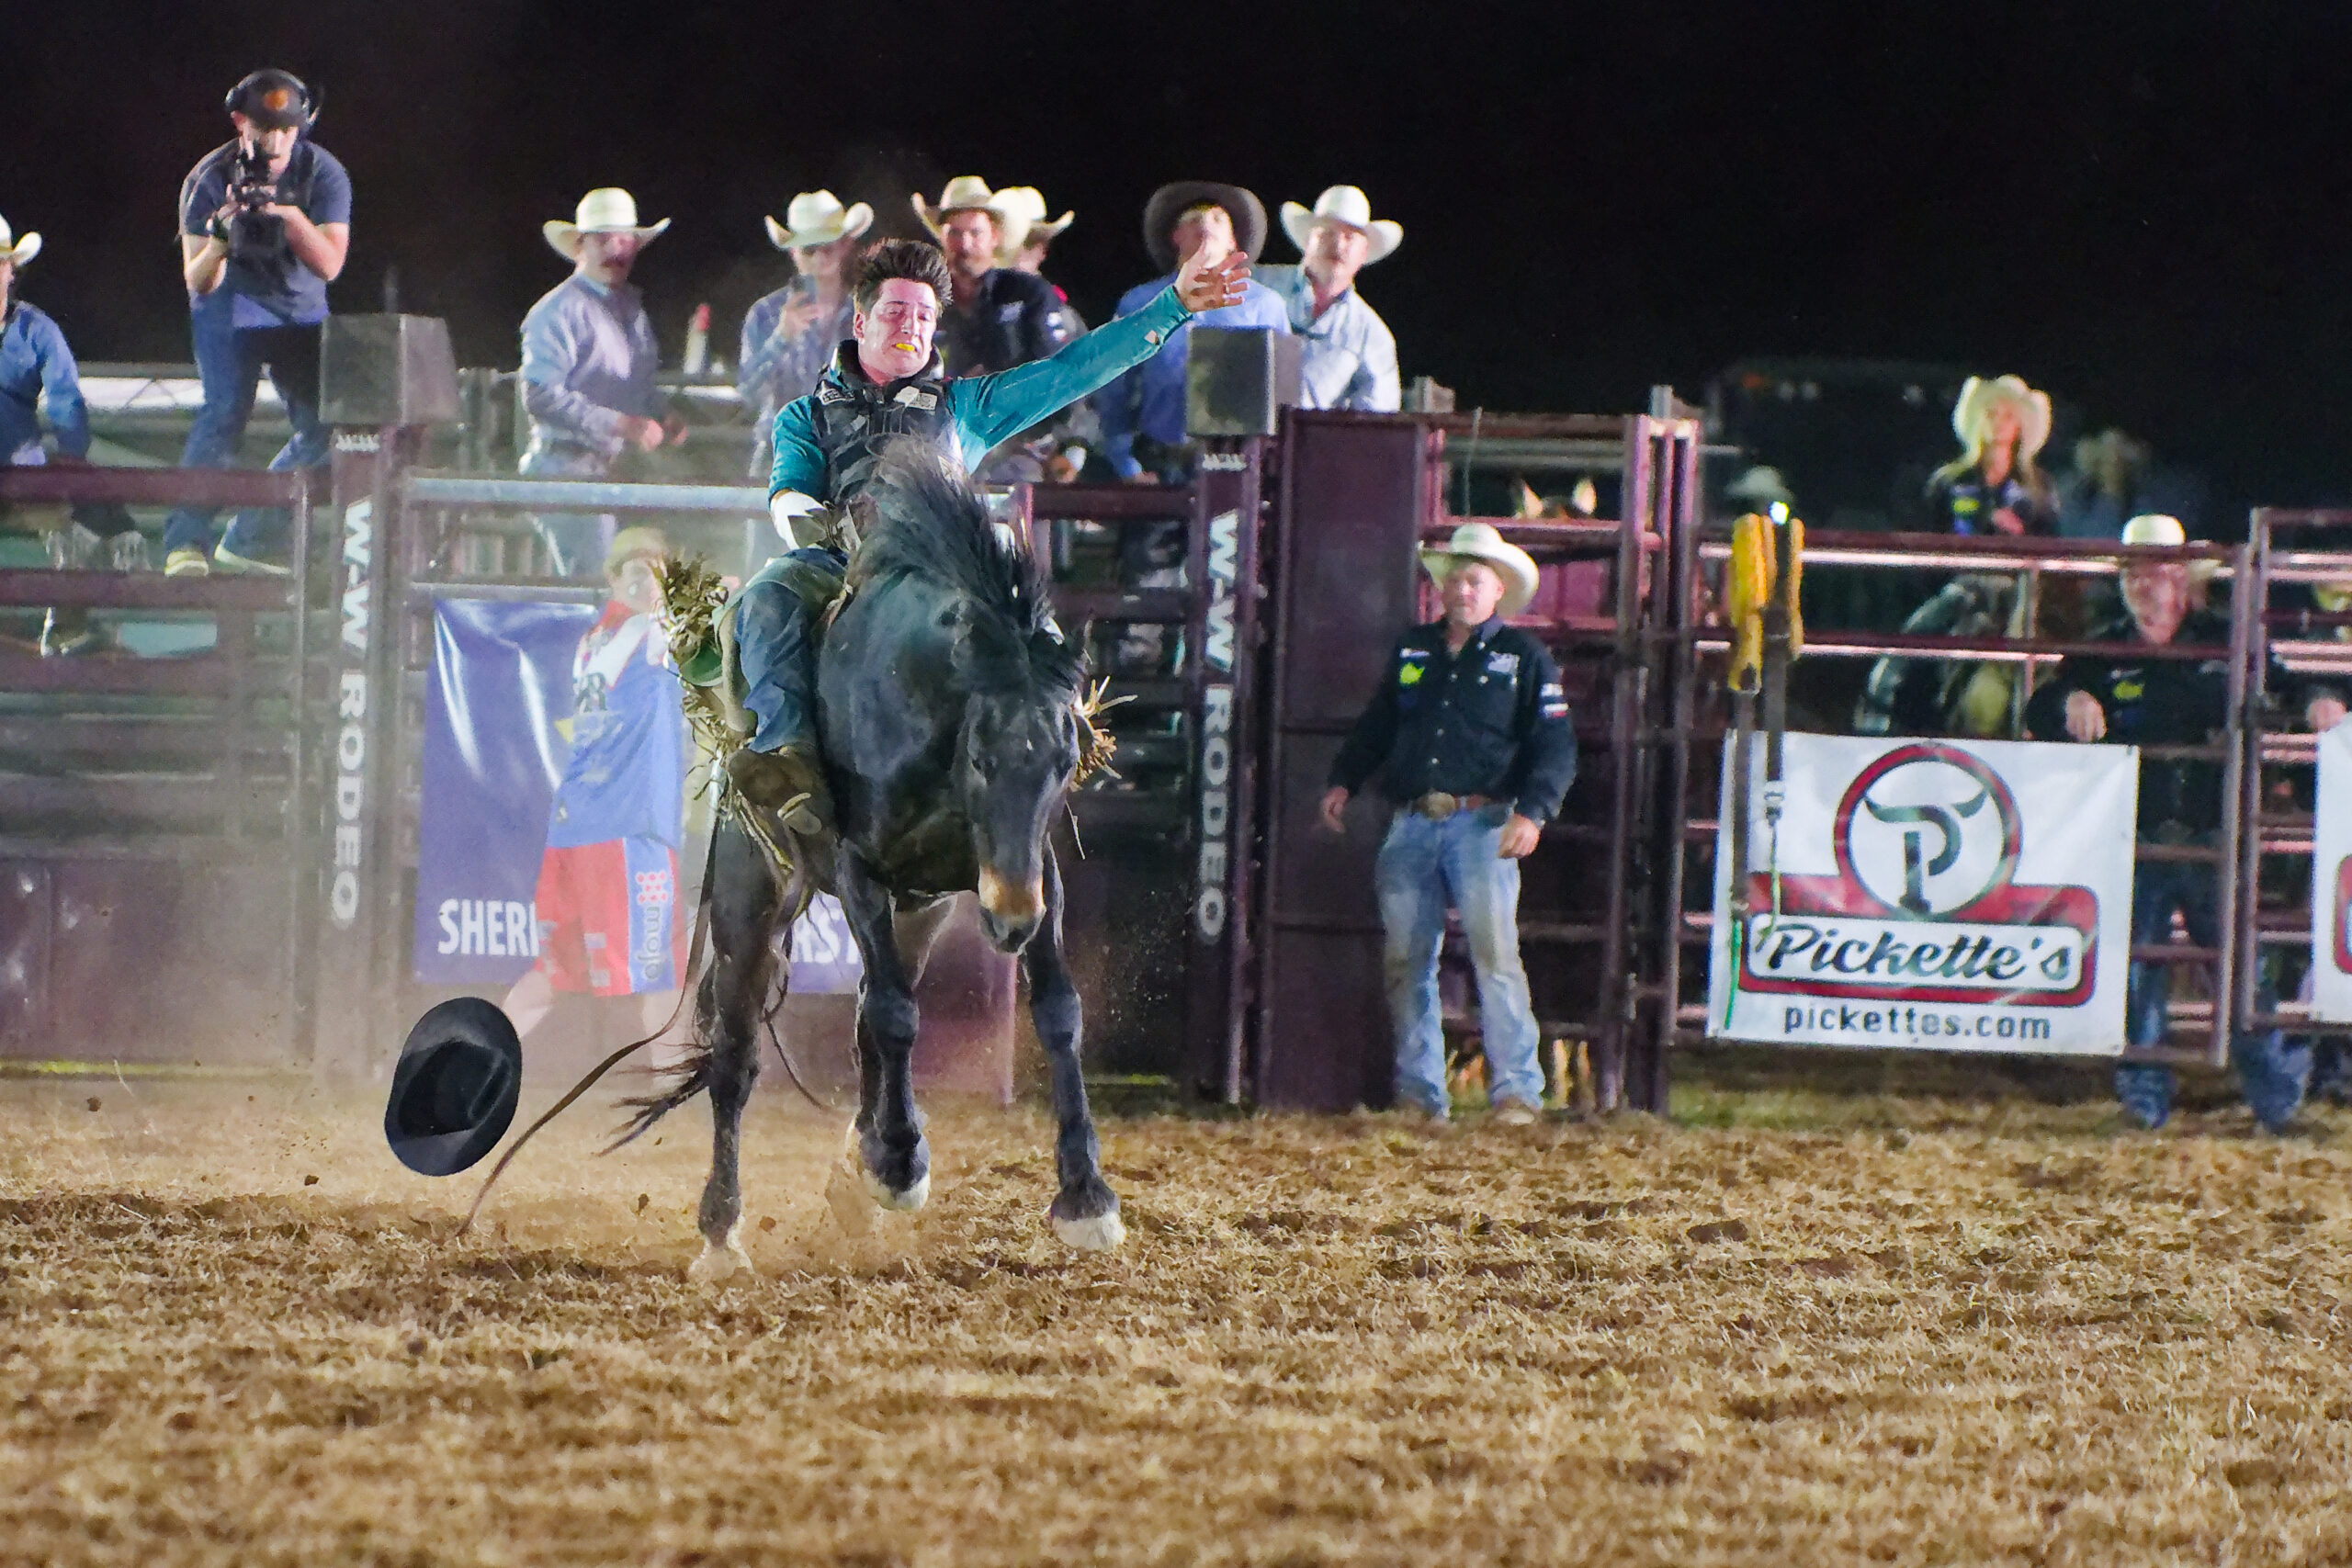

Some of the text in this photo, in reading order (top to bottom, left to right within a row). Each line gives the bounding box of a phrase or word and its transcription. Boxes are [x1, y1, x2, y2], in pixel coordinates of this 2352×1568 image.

[1206, 511, 1238, 671] W-W
[332, 498, 372, 923] W-W RODEO
[1198, 685, 1233, 939] RODEO
[637, 906, 664, 981] mojo
[1756, 923, 2071, 981] Pickette's
[1784, 1005, 2051, 1040] pickettes.com
